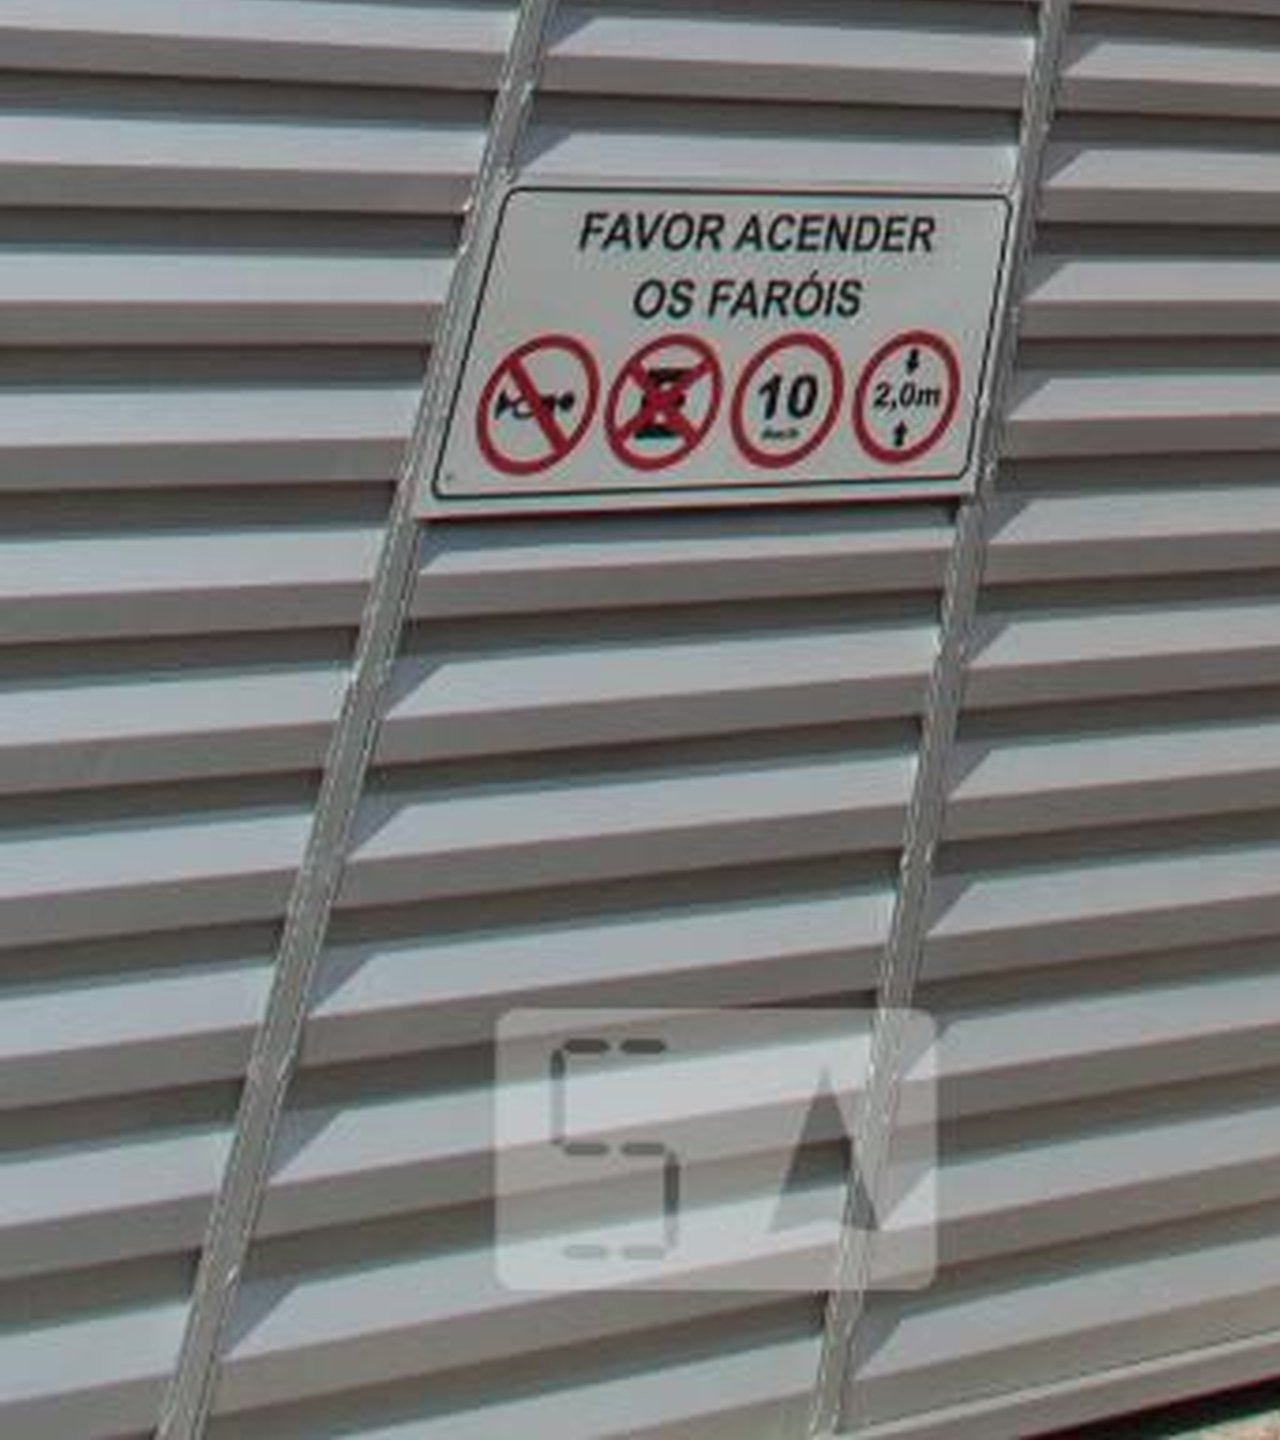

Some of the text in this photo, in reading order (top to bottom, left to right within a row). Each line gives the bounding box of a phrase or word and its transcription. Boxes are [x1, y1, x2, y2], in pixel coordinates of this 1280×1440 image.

[578, 210, 937, 253] FAVOR ACENDER
[632, 270, 864, 320] OS FARÓIS
[758, 373, 819, 421] 10
[873, 381, 942, 413] 2,0m
